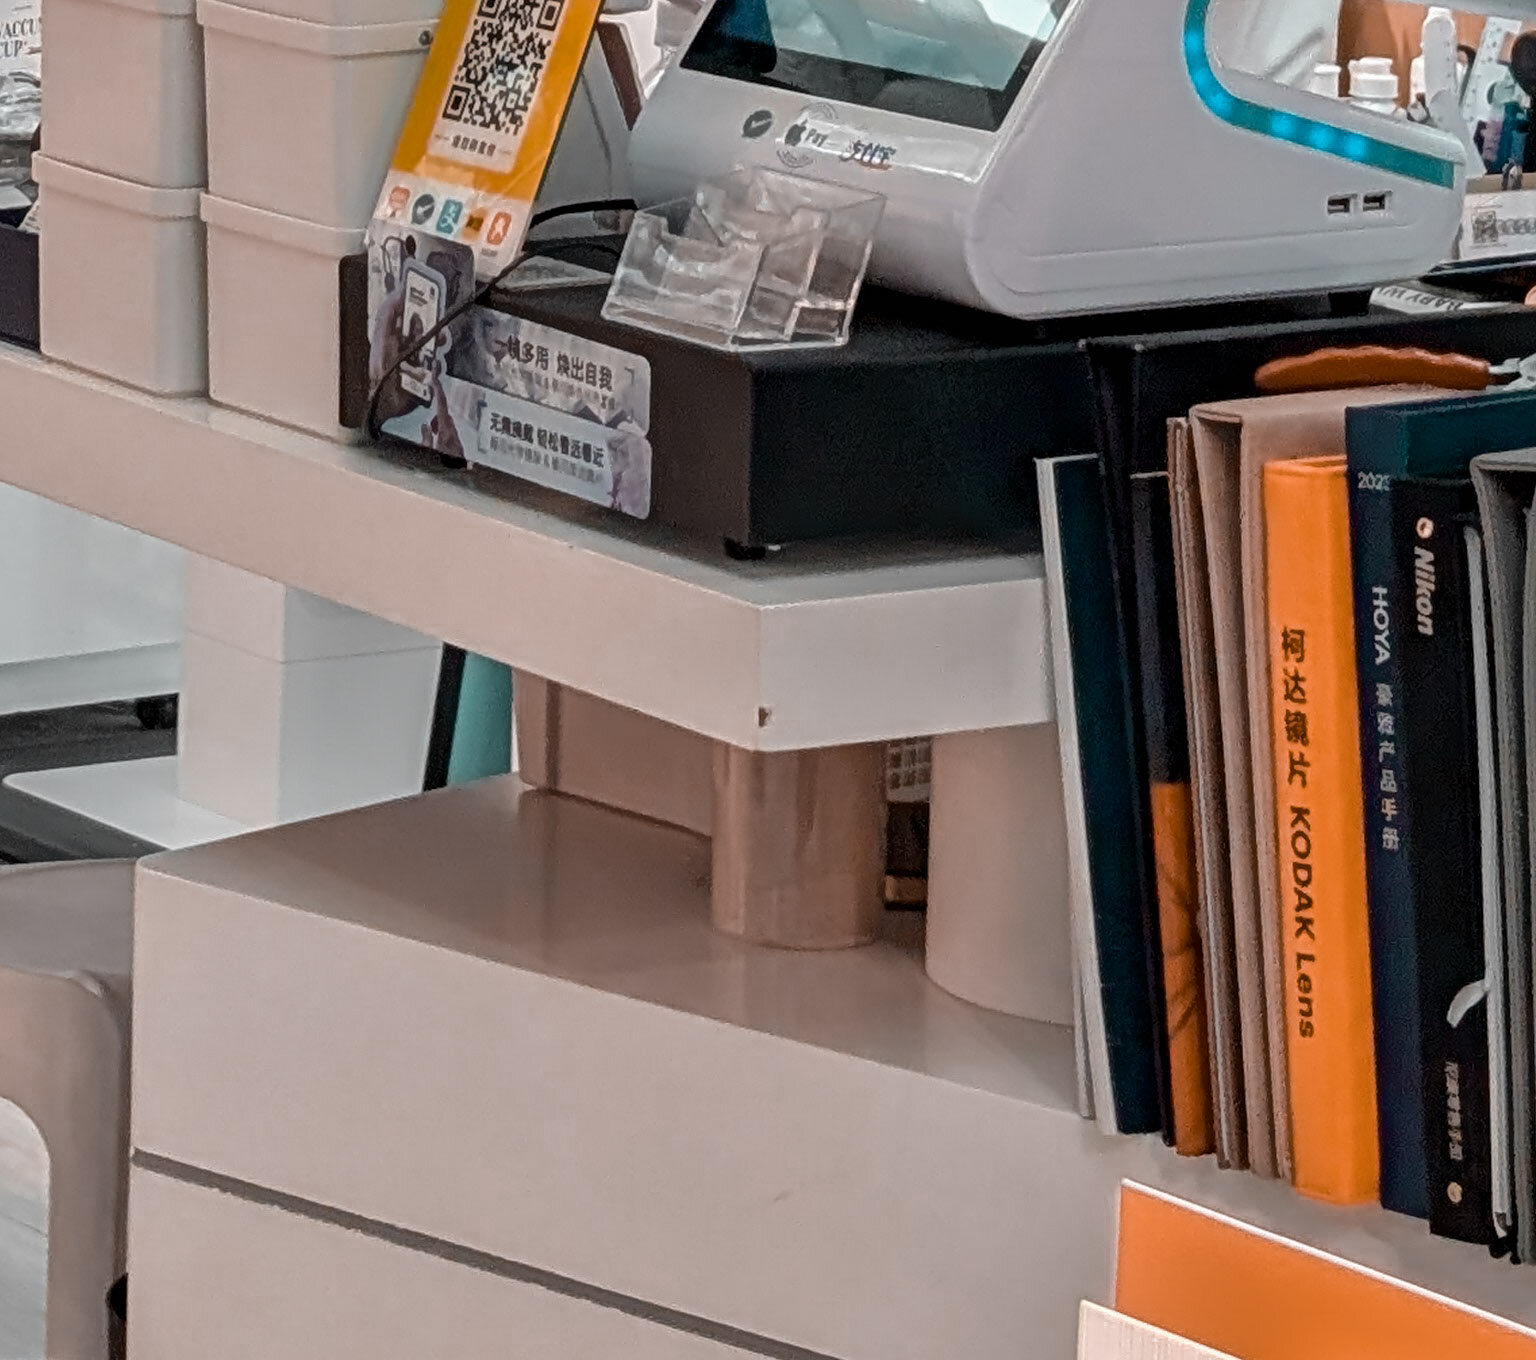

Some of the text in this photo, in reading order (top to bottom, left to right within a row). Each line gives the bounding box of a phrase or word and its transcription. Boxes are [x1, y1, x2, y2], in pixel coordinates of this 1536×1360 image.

[1371, 585, 1391, 666] HOYA
[1414, 544, 1436, 636] Nikon
[1281, 625, 1317, 1039] 柯达镜片 KODAK Lens
